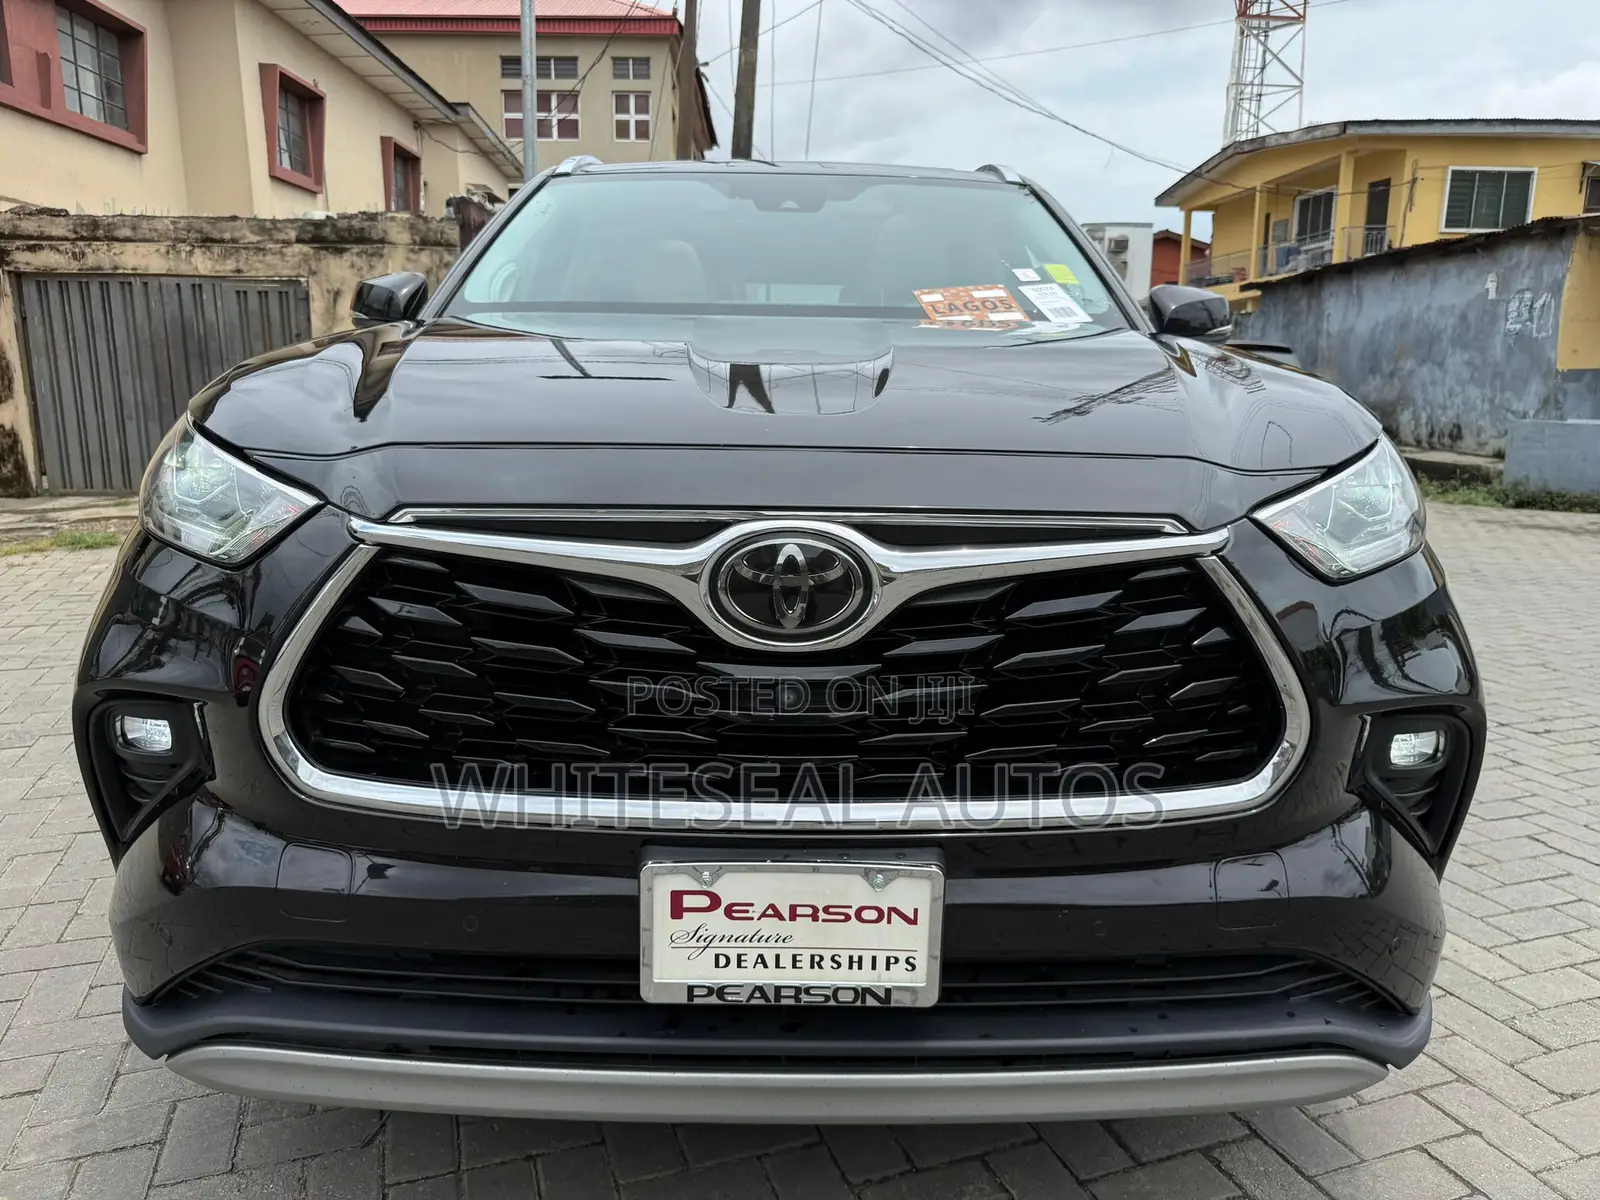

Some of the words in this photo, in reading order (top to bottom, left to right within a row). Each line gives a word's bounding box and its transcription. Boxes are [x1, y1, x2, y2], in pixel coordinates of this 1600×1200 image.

[930, 299, 1014, 315] LAGOS
[668, 922, 795, 961] Signature
[714, 953, 917, 972] DEALERSHIPS
[686, 982, 893, 1005] PEARSON
